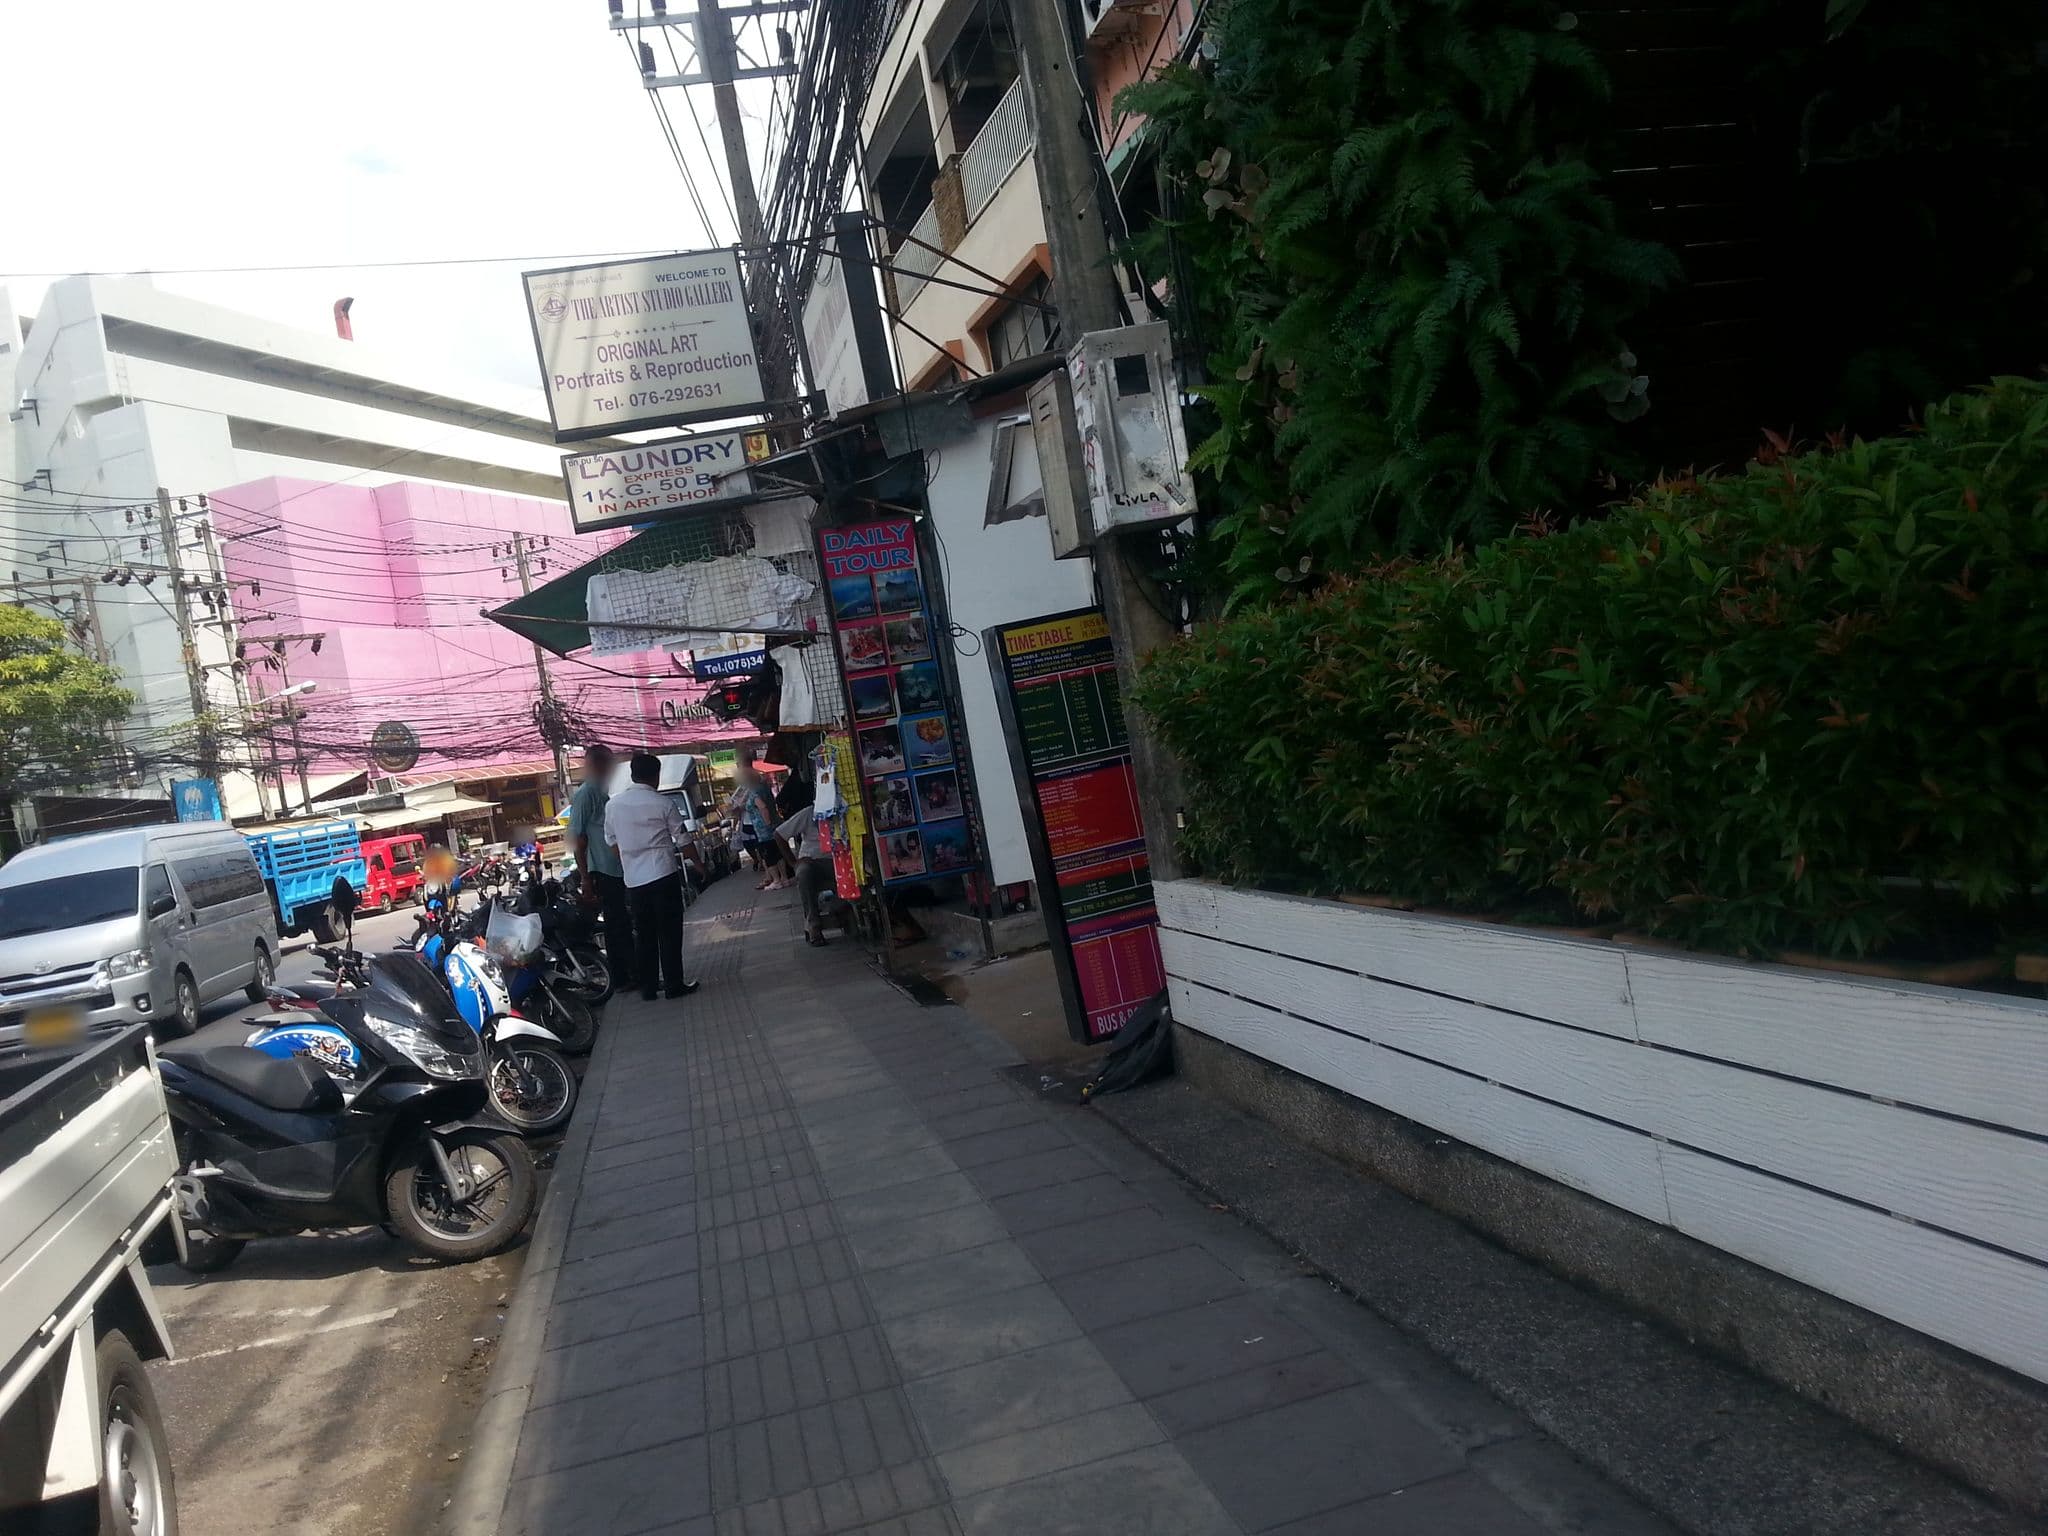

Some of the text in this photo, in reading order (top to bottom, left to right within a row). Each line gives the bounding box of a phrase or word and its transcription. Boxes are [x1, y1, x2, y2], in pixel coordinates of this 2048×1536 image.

[656, 267, 726, 283] WELCOME TO
[571, 280, 734, 321] THE ARTIST STUDIO GALLERY
[597, 334, 698, 363] ORIGINAL ART
[554, 352, 753, 392] Portraits & Reproduction
[594, 382, 722, 412] Tel. 076-292631
[580, 439, 735, 480] LAUNDRY
[624, 466, 694, 484] EXPRESS
[583, 490, 594, 503] 1
[660, 476, 688, 491] 50
[598, 486, 720, 514] IN ART SHOP
[824, 522, 910, 552] DAILY
[827, 547, 913, 575] TOUR
[1096, 1012, 1118, 1034] BUS
